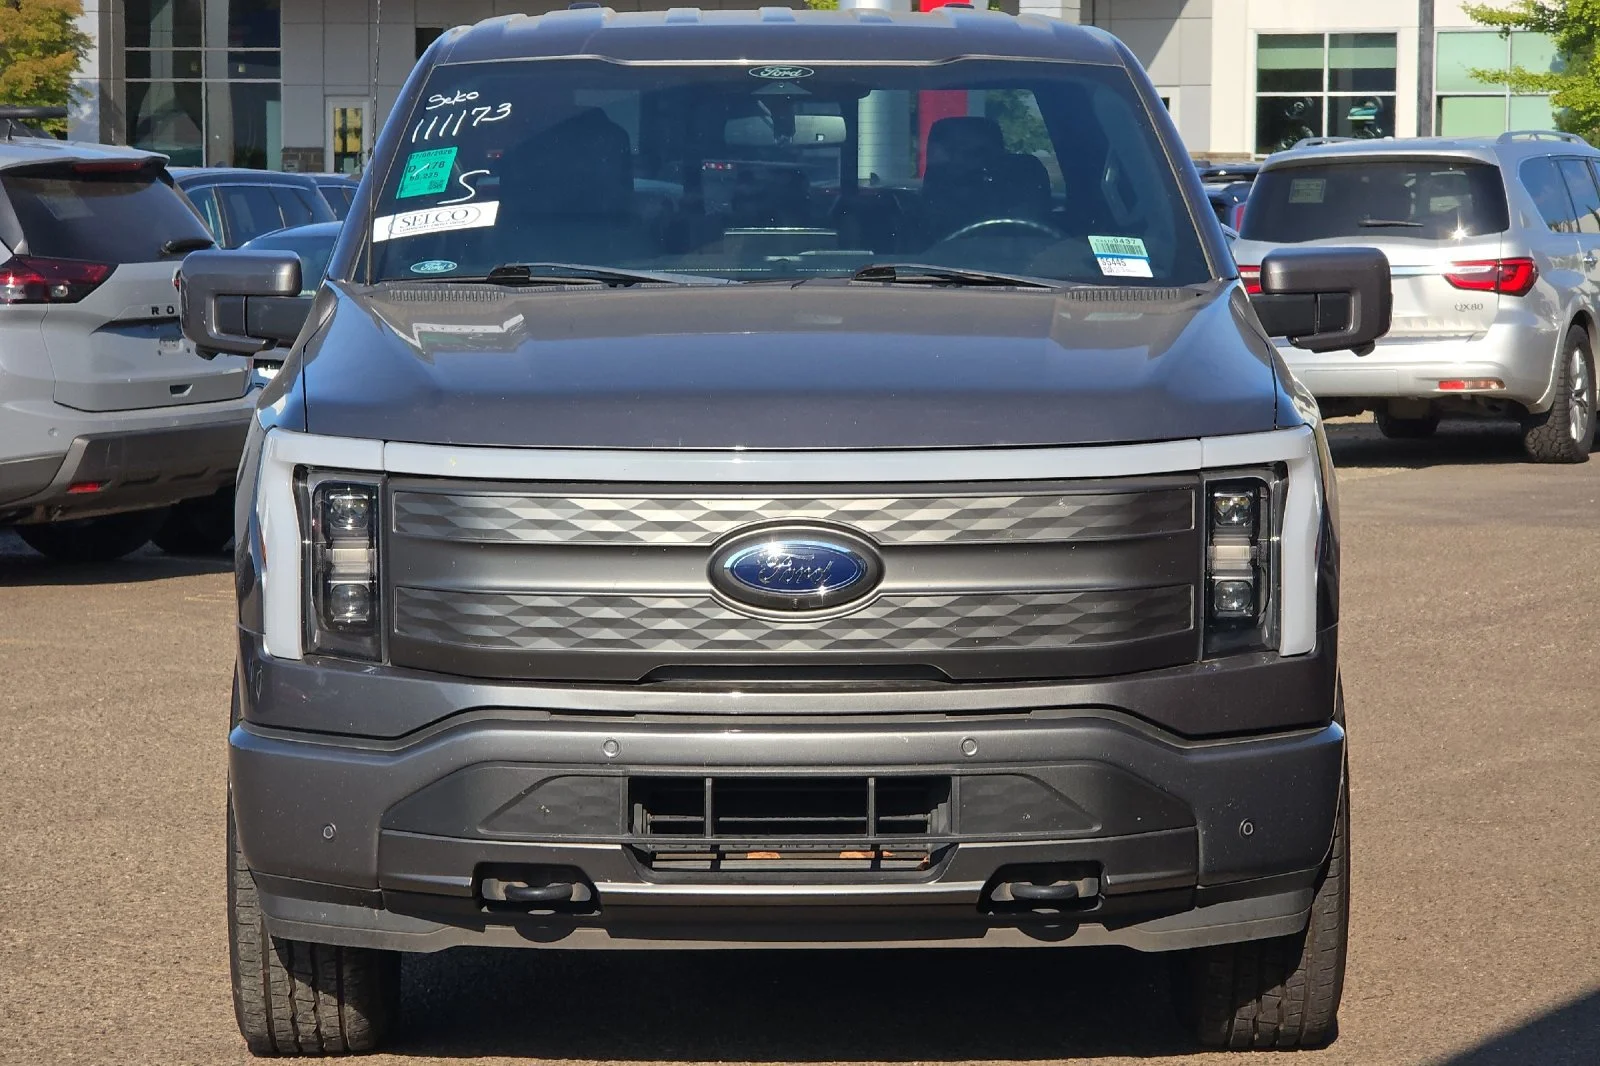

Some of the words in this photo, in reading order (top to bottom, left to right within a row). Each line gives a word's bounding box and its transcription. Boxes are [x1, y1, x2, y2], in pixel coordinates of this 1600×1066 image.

[760, 67, 803, 77] Ford
[402, 209, 469, 227] SELCO
[1454, 303, 1484, 313] QX80
[757, 552, 834, 585] Ford
